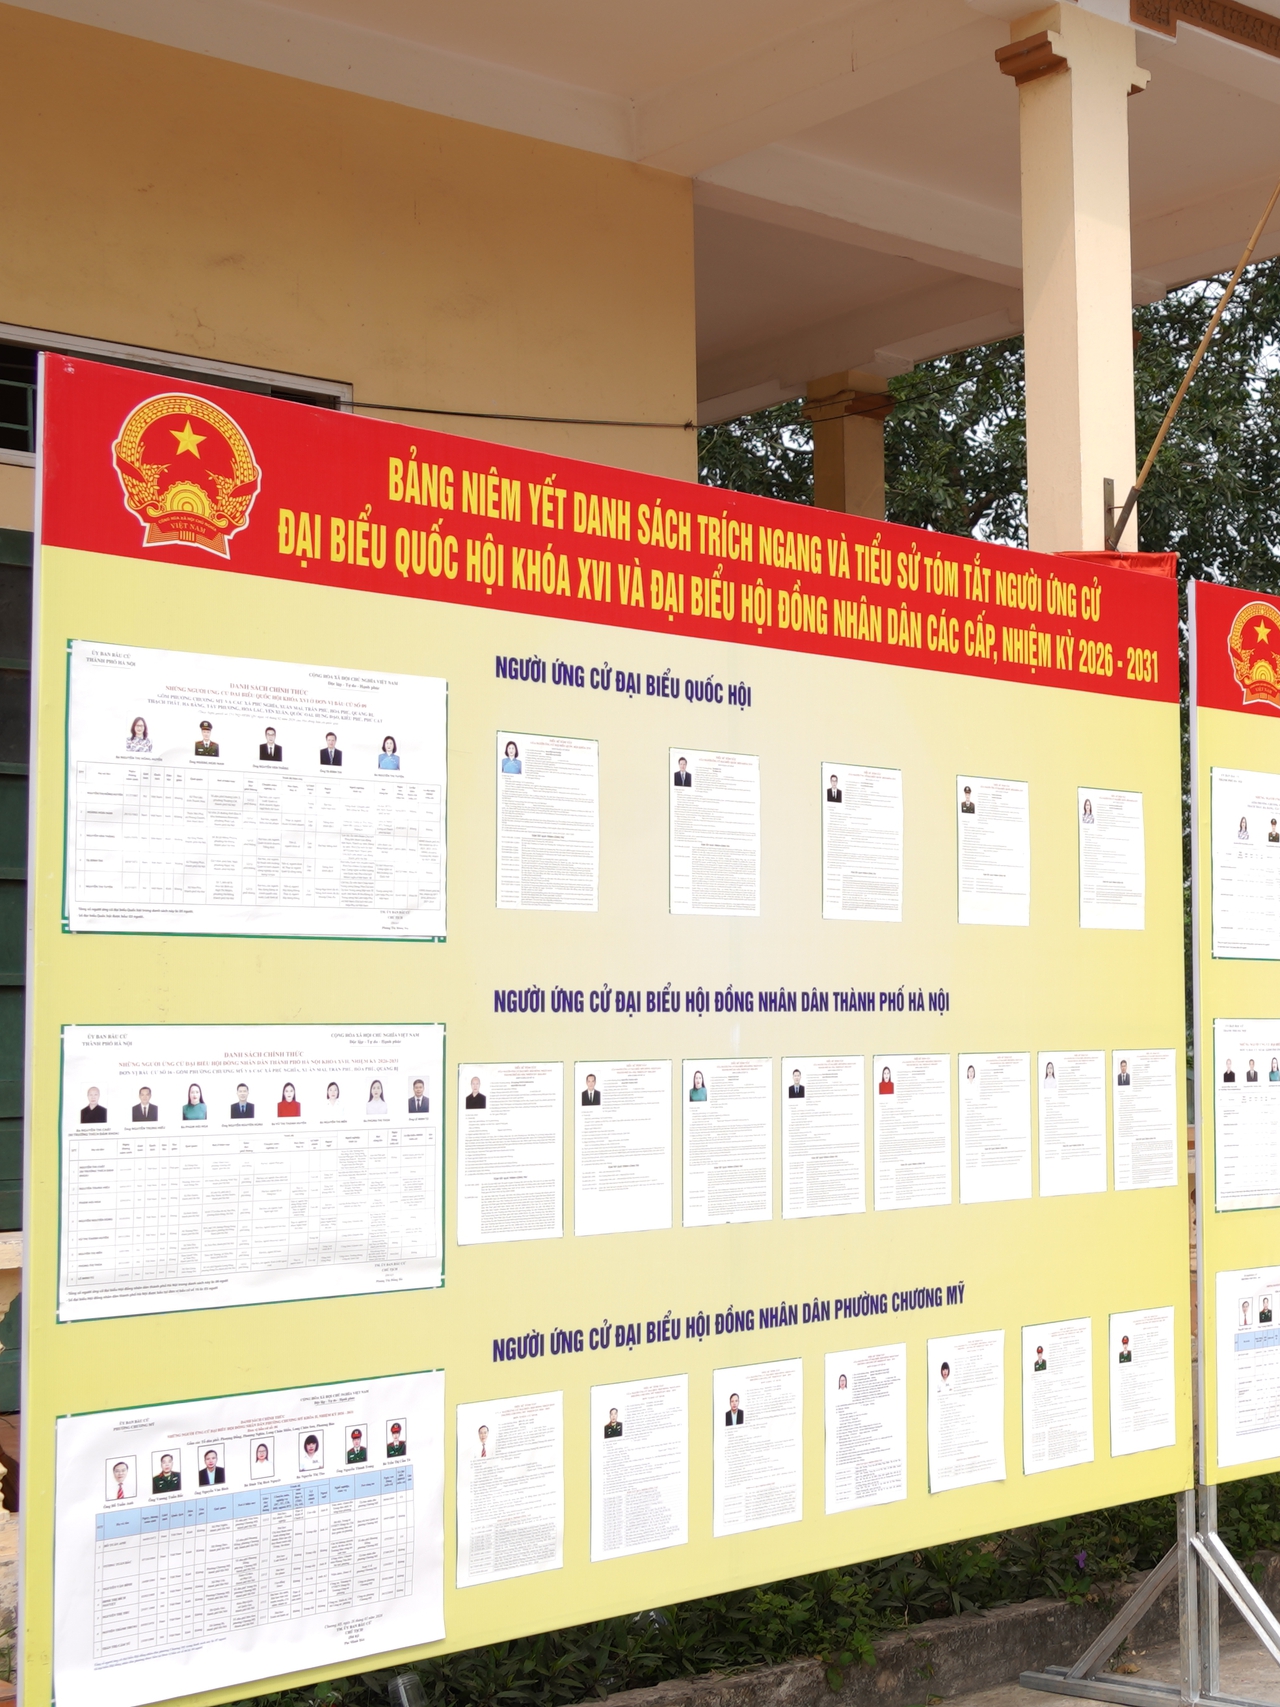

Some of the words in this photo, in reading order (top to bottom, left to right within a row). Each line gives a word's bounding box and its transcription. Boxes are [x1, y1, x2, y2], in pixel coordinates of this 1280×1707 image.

[389, 446, 453, 510] BẢNG
[462, 467, 520, 522] NIÊM
[529, 474, 566, 529] YẾT
[574, 492, 630, 541] DANH
[638, 498, 691, 551] SÁCH
[697, 510, 752, 564] TRÍCH
[759, 526, 821, 574] NGANG
[827, 533, 850, 579] VÀ
[855, 533, 891, 586] TIỂU
[897, 542, 921, 591] SỬ
[924, 552, 958, 597] TÓM
[963, 553, 991, 603] TẮT
[996, 568, 1042, 612] NGƯỜI
[1047, 573, 1076, 617] ỨNG
[1081, 577, 1101, 622] CỬ
[278, 508, 321, 568] ĐẠI
[331, 504, 386, 569] BIỂU
[395, 518, 458, 579] QUỐC
[467, 533, 504, 595] HỘI
[512, 543, 571, 596] KHÓA
[578, 557, 611, 602] XVI
[618, 558, 644, 607] VÀ
[650, 569, 684, 621] ĐẠI
[691, 564, 734, 621] BIỂU
[742, 578, 772, 634] HỘI
[778, 580, 827, 634] ĐỒNG
[834, 595, 882, 642] NHÂN
[888, 602, 921, 648] DÂN
[927, 609, 959, 654] CÁC
[965, 610, 997, 664] CẤP,
[1003, 624, 1051, 673] NHIỆM
[1056, 629, 1074, 670] KỲ
[1079, 639, 1113, 677] 2026
[1127, 647, 1158, 683] 2031
[496, 655, 546, 683] NGƯỜI
[552, 658, 584, 688] ỨNG
[590, 662, 612, 690] CỬ
[615, 671, 640, 698] ĐẠI
[646, 668, 679, 699] BIỂU
[685, 675, 723, 703] QUỐC
[728, 681, 751, 711] HỘI
[494, 985, 545, 1013] NGƯỜI
[551, 986, 584, 1012] ỨNG
[590, 983, 612, 1012] CỬ
[615, 991, 641, 1017] ĐẠI
[647, 982, 680, 1012] BIỂU
[686, 987, 709, 1017] HỘI
[714, 984, 753, 1012] ĐỒNG
[759, 987, 796, 1012] NHÂN
[802, 987, 828, 1011] DÂN
[833, 988, 875, 1011] THÀNH
[880, 985, 904, 1011] PHỐ
[909, 988, 925, 1011] HÀ
[929, 988, 949, 1015] NỘI
[493, 1329, 544, 1362] NGƯỜI
[551, 1327, 583, 1355] ỨNG
[589, 1319, 612, 1350] CỬ
[615, 1323, 641, 1349] ĐẠI
[647, 1310, 680, 1343] BIỂU
[686, 1311, 710, 1341] HỘI
[715, 1305, 754, 1334] ĐỒNG
[760, 1301, 798, 1329] NHÂN
[803, 1297, 830, 1323] DÂN
[835, 1291, 887, 1319] PHƯỜNG
[892, 1287, 942, 1312] CHƯƠNG
[947, 1281, 964, 1305] MỸ
